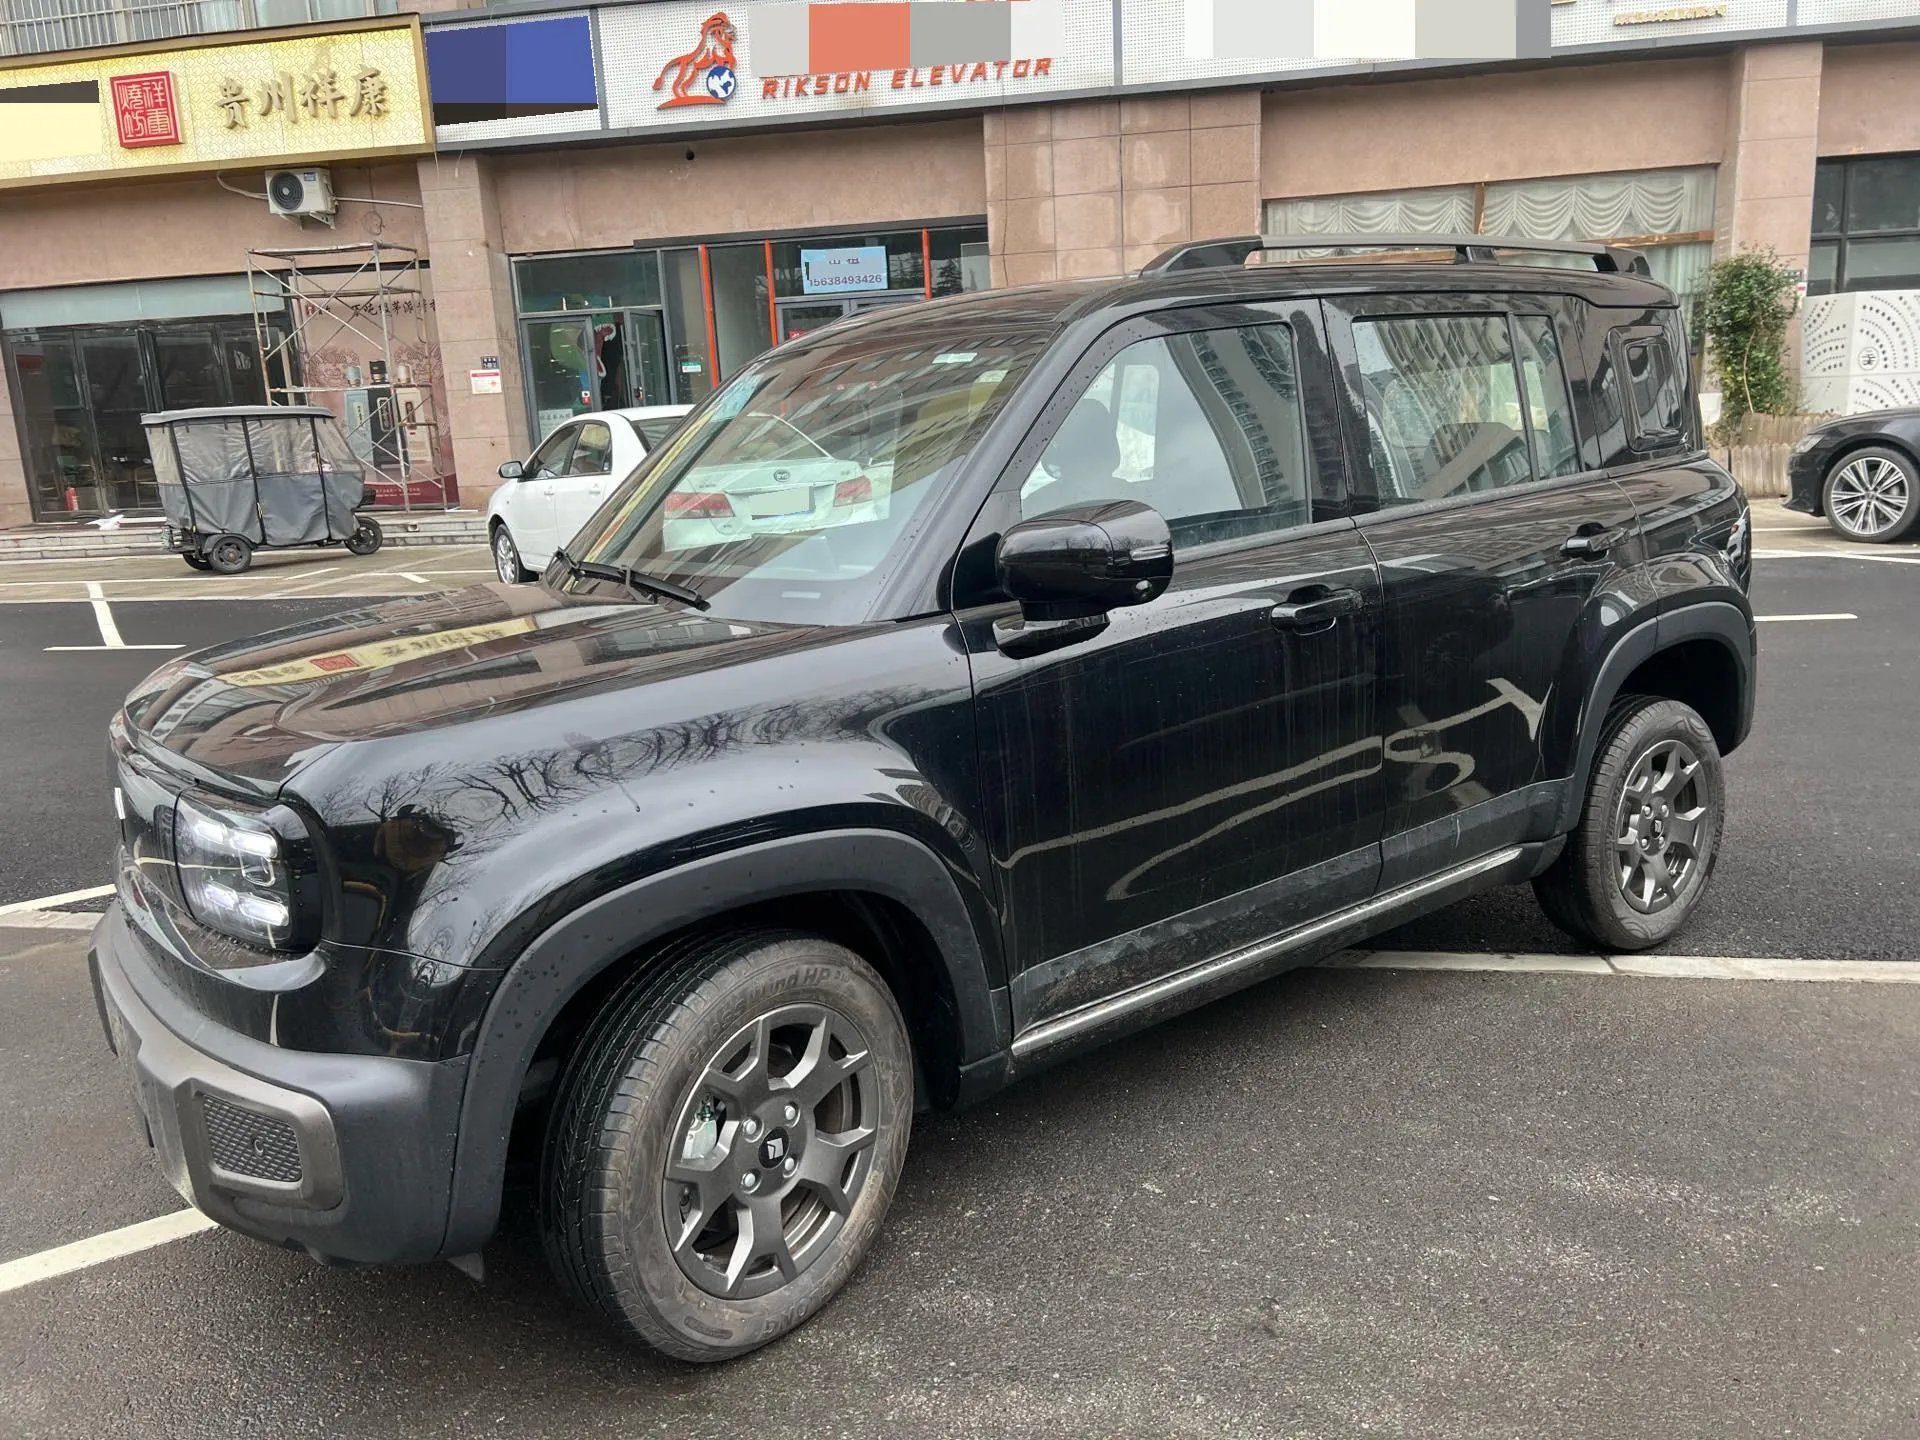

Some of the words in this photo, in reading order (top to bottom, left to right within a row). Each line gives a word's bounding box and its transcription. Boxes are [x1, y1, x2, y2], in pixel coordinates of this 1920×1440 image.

[214, 64, 389, 130] 贵州祥康
[761, 71, 871, 100] RIKSON
[890, 57, 1054, 89] ELEVATOR
